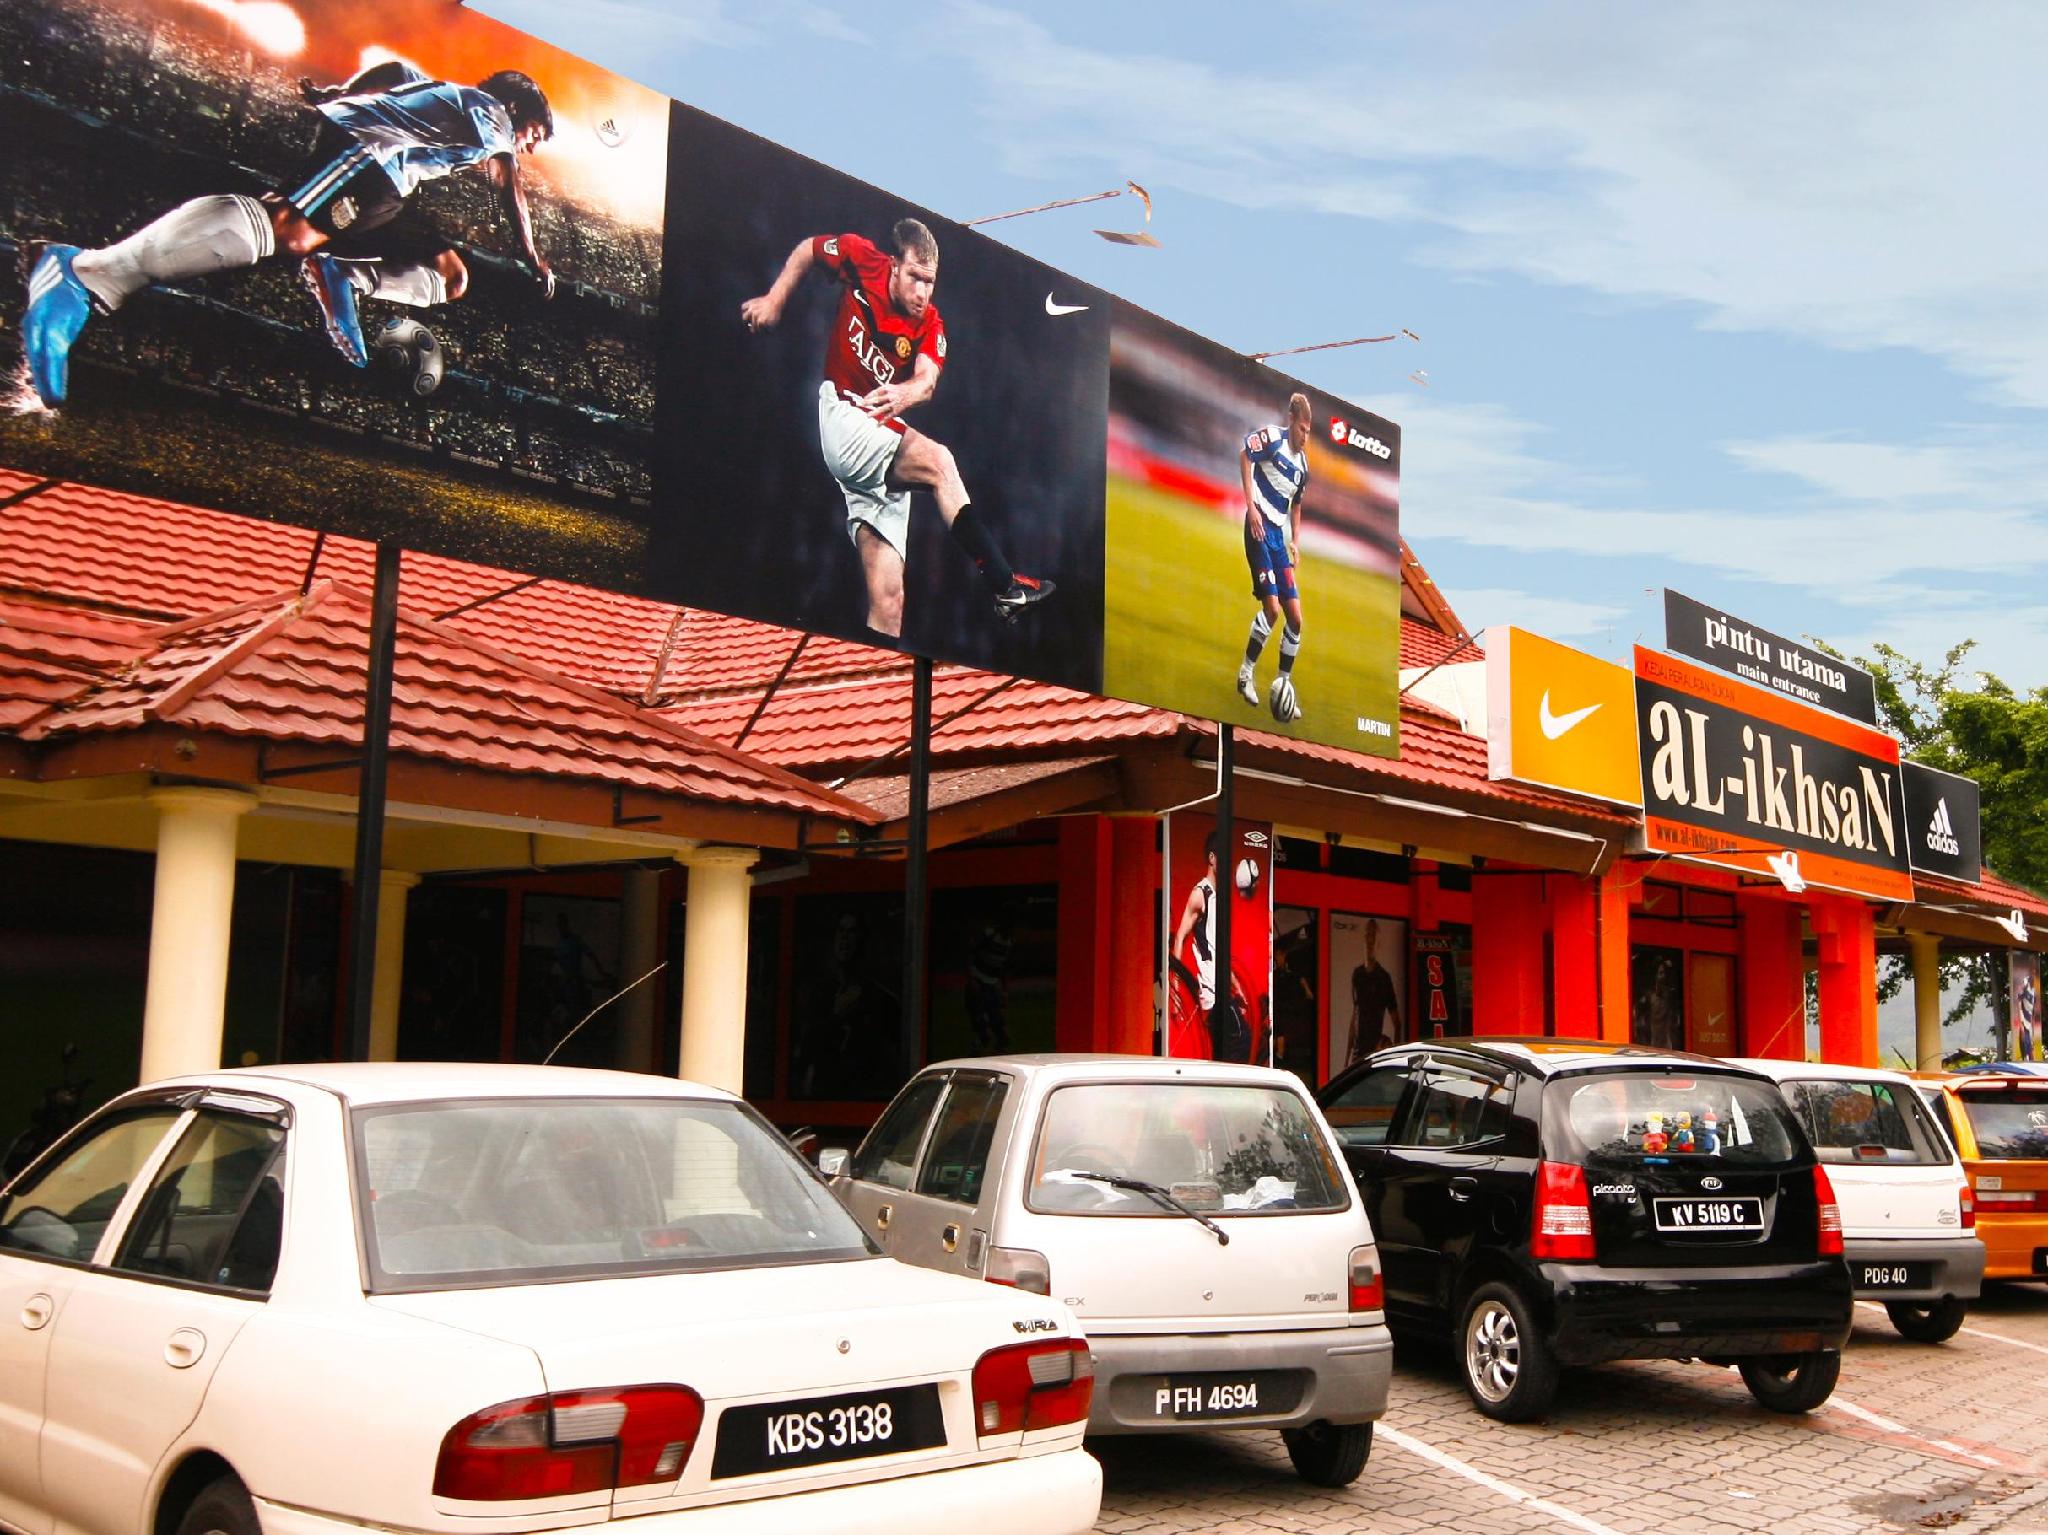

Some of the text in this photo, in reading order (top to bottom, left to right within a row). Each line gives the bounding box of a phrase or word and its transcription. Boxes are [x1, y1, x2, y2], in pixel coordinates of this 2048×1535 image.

[1705, 617, 1847, 693] pintu utama
[1737, 662, 1821, 703] main entrance
[1357, 717, 1391, 737] MARTIN
[1927, 832, 1959, 856] adidas
[1672, 1204, 1744, 1226] KV 5119 C
[1864, 1267, 1908, 1284] PDG 40
[1207, 1383, 1258, 1410] 4694
[767, 1402, 893, 1456] KBS 3138
